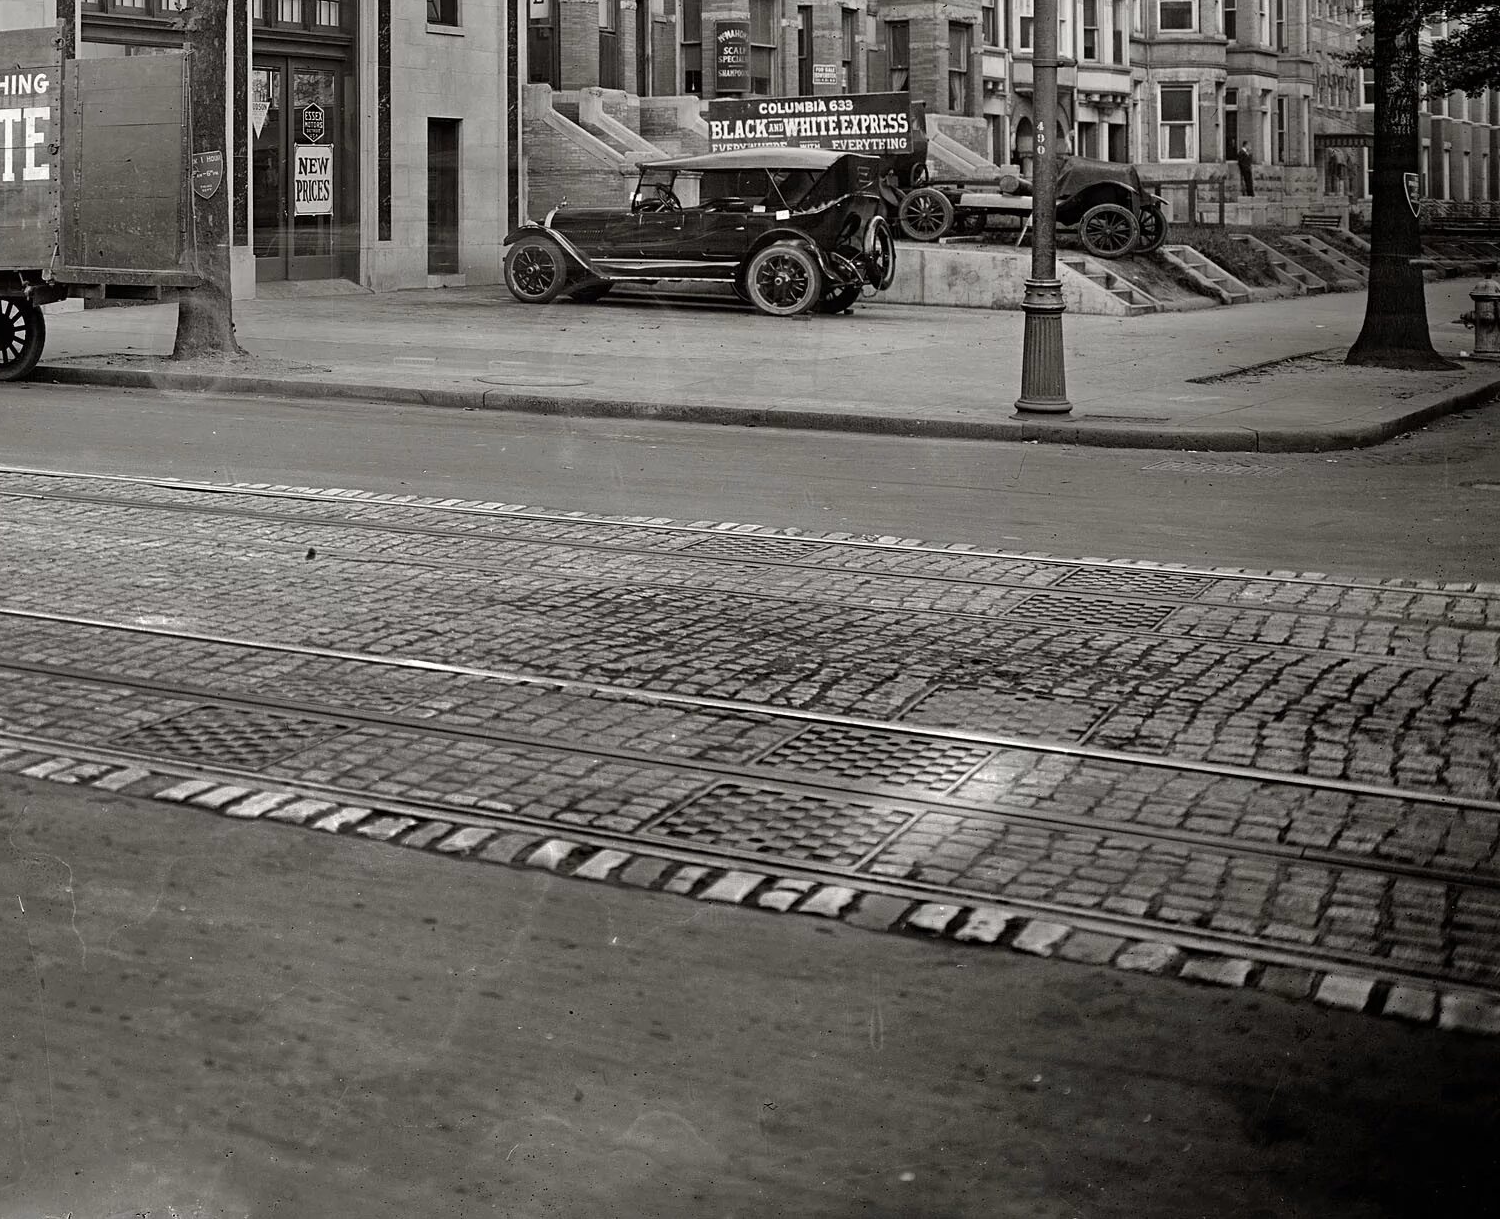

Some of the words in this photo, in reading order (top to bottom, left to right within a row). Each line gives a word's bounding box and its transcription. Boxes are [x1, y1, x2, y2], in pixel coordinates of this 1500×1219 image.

[305, 111, 323, 122] ESSEX
[759, 100, 827, 115] COLUMBIA
[829, 100, 854, 112] 633
[710, 118, 769, 140] BLACK
[768, 122, 784, 133] AND
[783, 115, 839, 137] WHITE
[840, 113, 909, 135] EXPRESS
[832, 138, 908, 151] EVERYTHING
[1036, 121, 1046, 155] 490
[298, 156, 329, 176] NEW
[295, 179, 330, 203] PRICES
